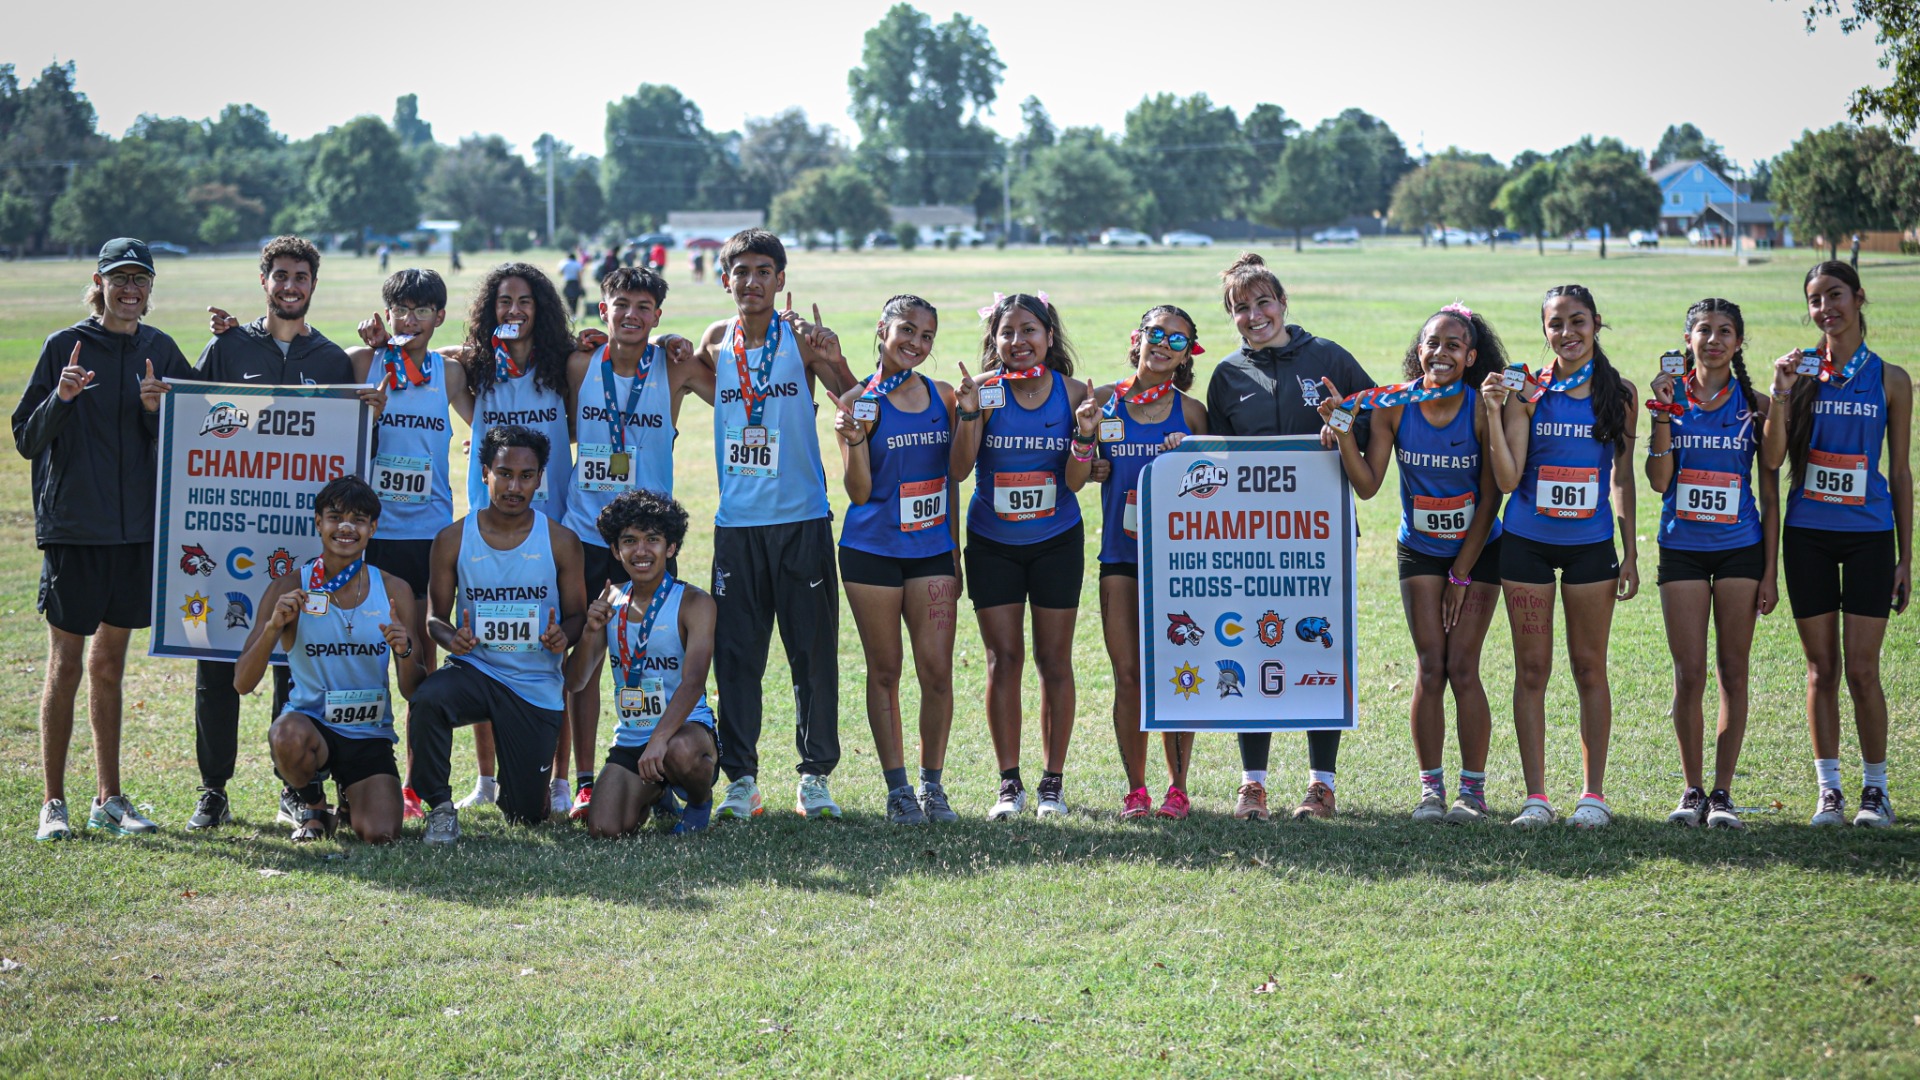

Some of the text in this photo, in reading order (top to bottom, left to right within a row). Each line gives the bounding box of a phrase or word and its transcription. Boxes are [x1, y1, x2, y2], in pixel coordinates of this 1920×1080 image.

[720, 382, 799, 405] SPAANS
[1303, 397, 1320, 407] XC
[482, 407, 557, 425] SPARTANS
[582, 405, 663, 428] SPAANS
[1811, 400, 1878, 418] UTHEAST
[199, 408, 316, 437] ACAC 2025
[378, 413, 445, 432] PARTANS
[1535, 422, 1593, 438] SOUTHE
[886, 430, 950, 450] SOUTHEAST
[985, 434, 1071, 451] SOUTHEAST
[1110, 443, 1162, 457] SOUTHE
[1672, 435, 1749, 452] OUTHEAST
[730, 443, 771, 466] 3916
[1398, 448, 1478, 469] SOUTHEAST
[187, 449, 345, 483] CHAMPIONS
[380, 470, 426, 493] 3910
[1178, 466, 1229, 497] ACAC
[1237, 465, 1297, 493] 2025
[1815, 469, 1855, 493] 958
[188, 487, 316, 510] HIGH SCHOOL BO
[1009, 489, 1043, 510] 957
[1550, 484, 1586, 507] 961
[1688, 488, 1727, 511] 955
[912, 495, 941, 519] 960
[184, 510, 322, 537] CROSS-COUNT
[1167, 510, 1330, 541] CHAMPIONS
[1426, 511, 1465, 531] 956
[1169, 551, 1326, 570] HIGH SCHOOL GIRLS
[465, 585, 548, 602] SPARTANS
[1169, 575, 1332, 598] CROSS-COUNTRY
[484, 621, 531, 641] 3914
[305, 641, 387, 657] SPARTANS
[1294, 673, 1338, 686] JETS
[331, 705, 378, 723] 3944
[621, 696, 662, 719] 46
